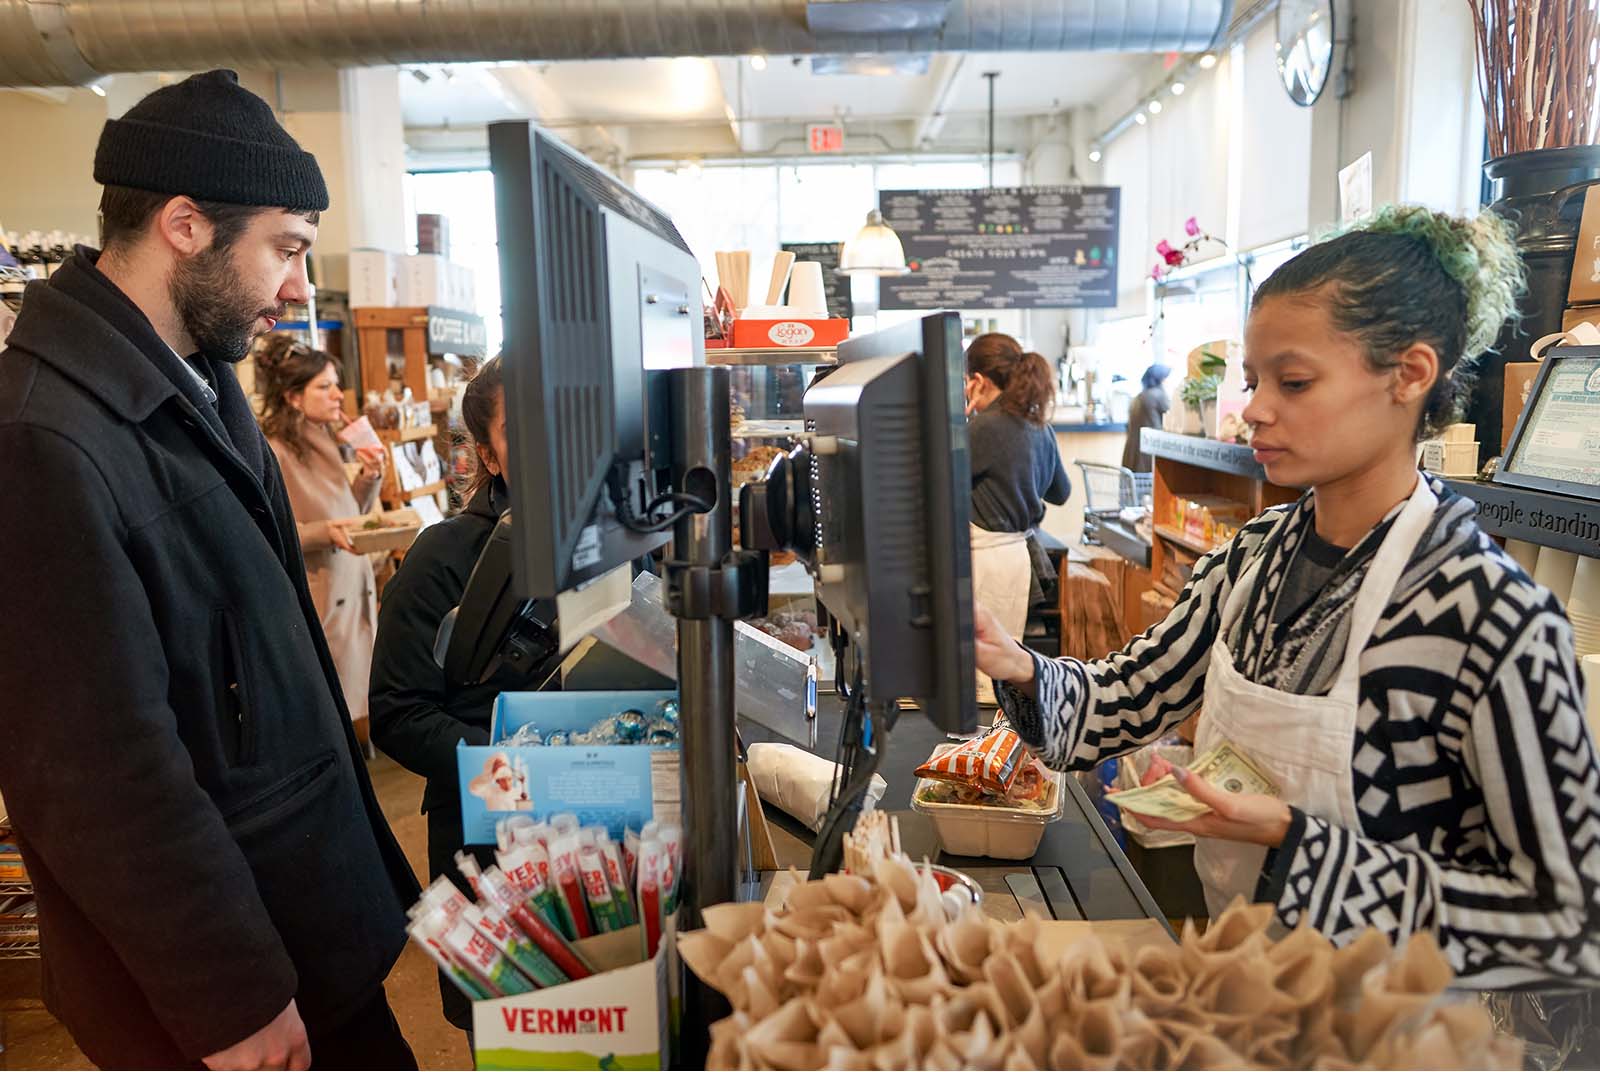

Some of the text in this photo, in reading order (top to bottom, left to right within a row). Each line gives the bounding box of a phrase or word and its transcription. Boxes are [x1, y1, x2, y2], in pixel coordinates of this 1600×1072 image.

[431, 316, 463, 344] COFFEE
[1476, 500, 1600, 543] people standin
[501, 1006, 628, 1034] VERMONT
